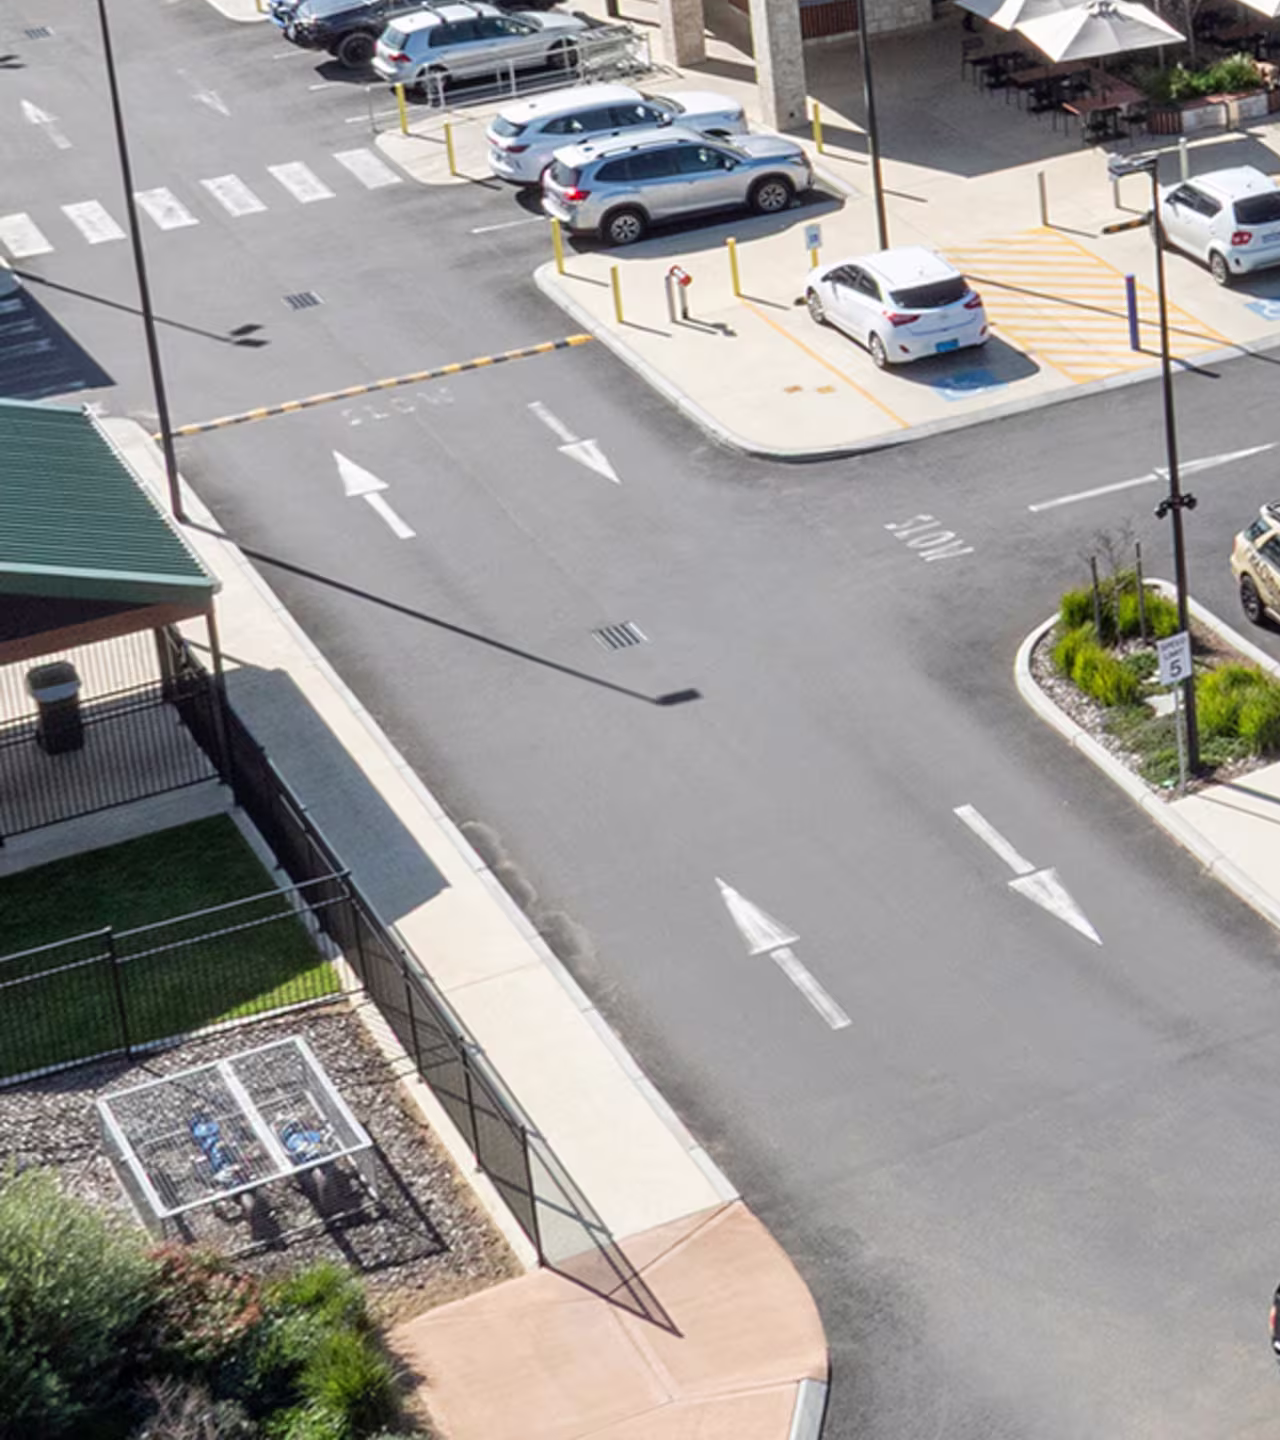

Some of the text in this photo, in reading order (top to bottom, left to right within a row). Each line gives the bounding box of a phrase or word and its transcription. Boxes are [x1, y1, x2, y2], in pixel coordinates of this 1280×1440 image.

[883, 514, 975, 562] SLOW
[1160, 634, 1187, 652] SPEED
[1170, 659, 1182, 678] 5
